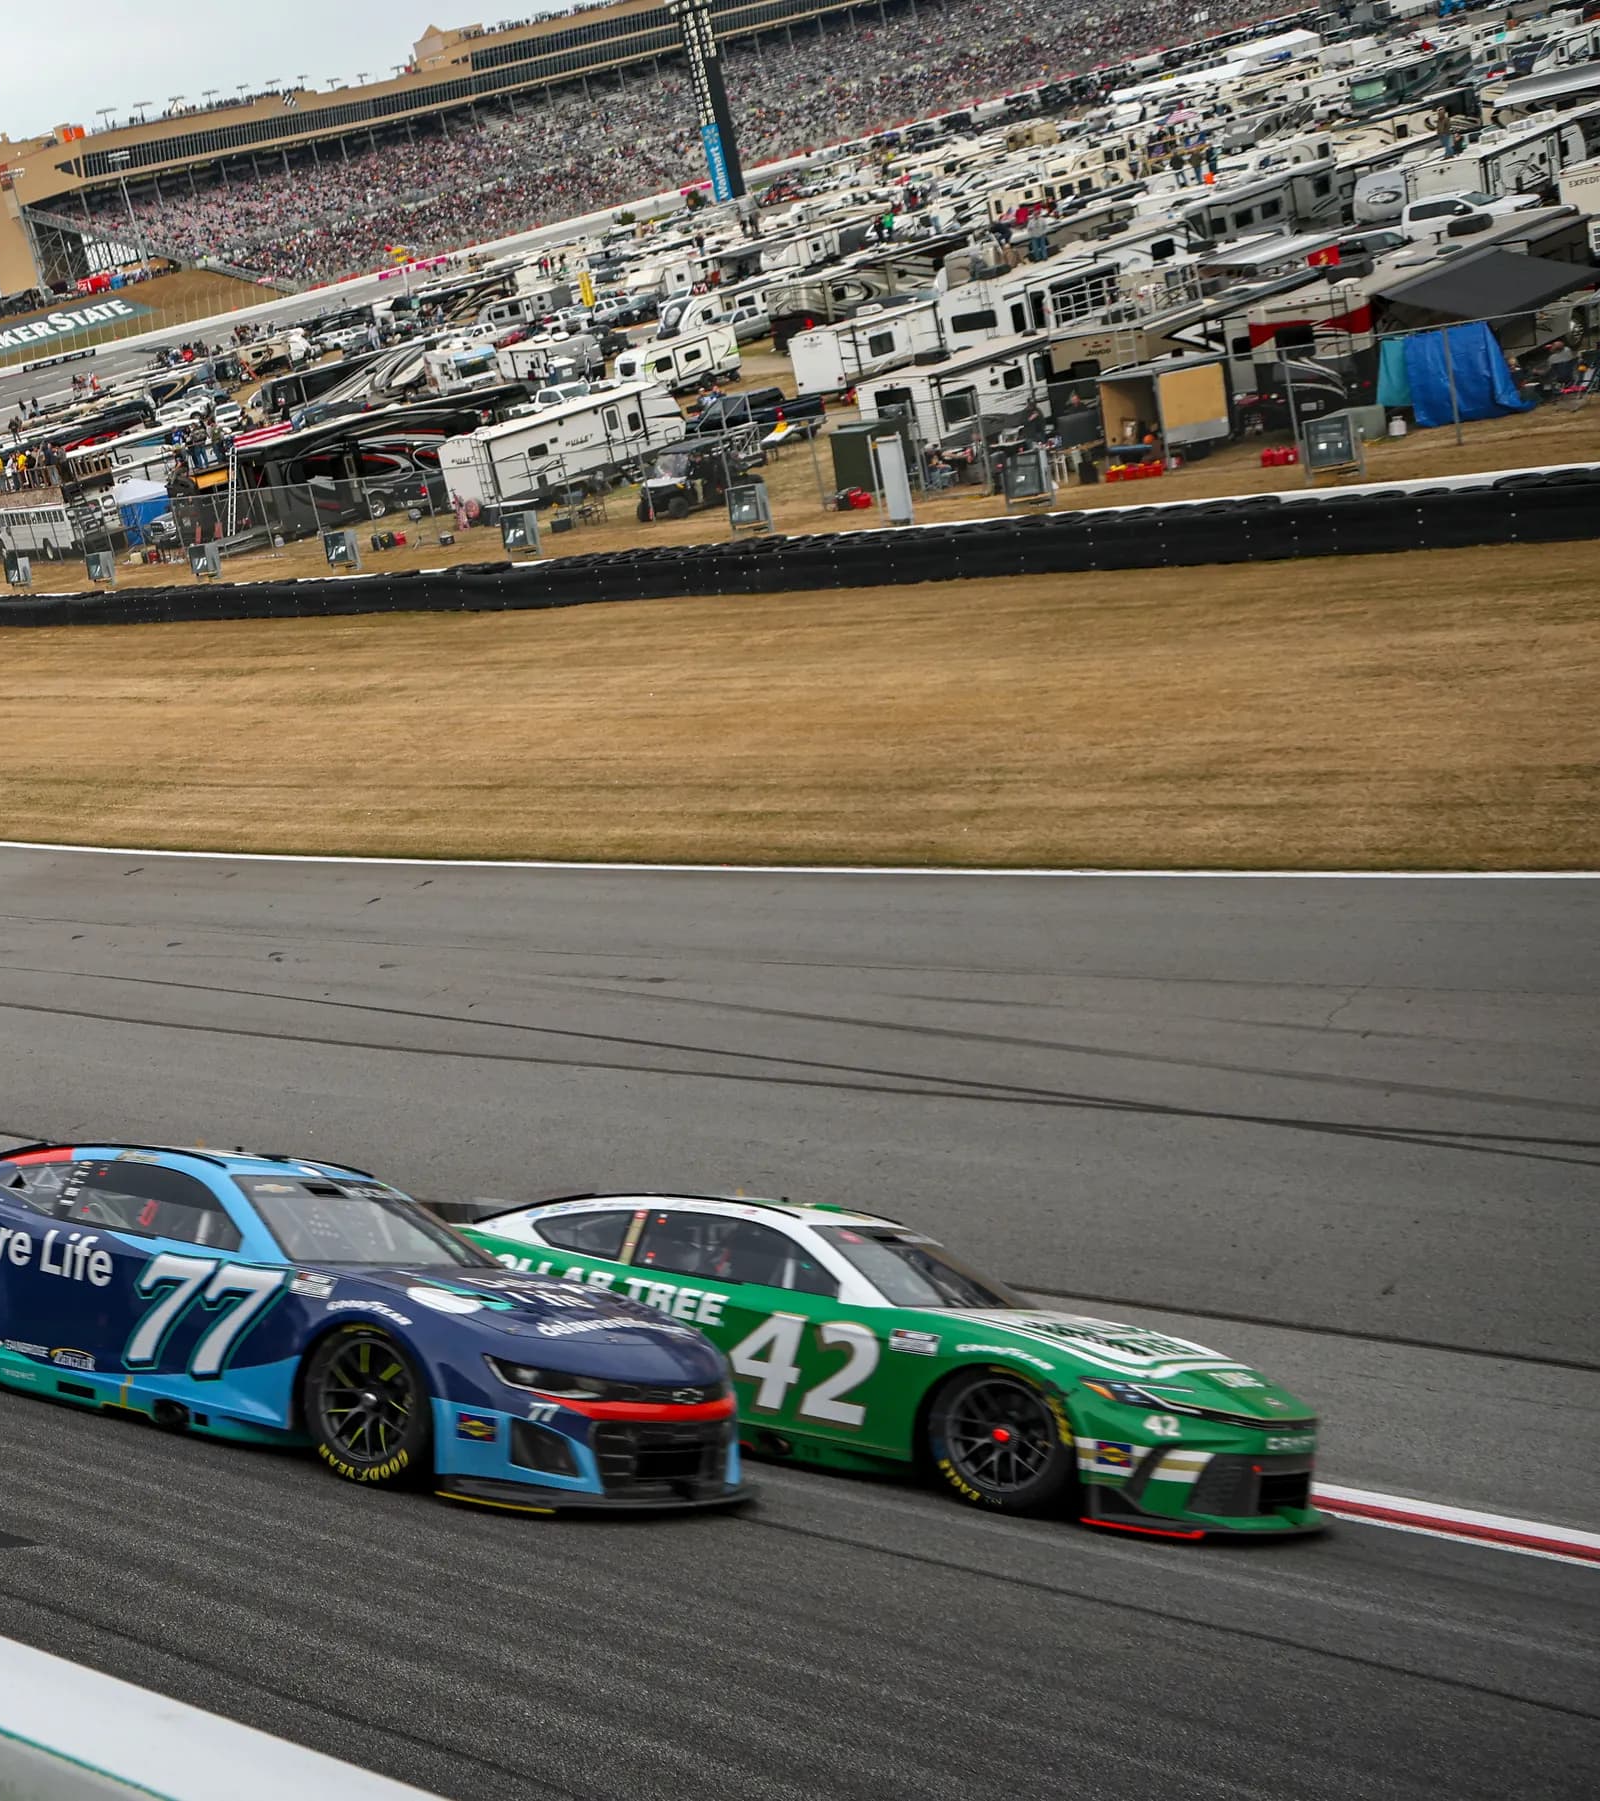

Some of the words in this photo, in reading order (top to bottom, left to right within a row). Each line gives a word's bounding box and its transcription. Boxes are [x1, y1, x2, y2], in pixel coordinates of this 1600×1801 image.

[710, 146, 730, 200] Walmart
[1568, 177, 1600, 189] EXPEDI
[47, 299, 134, 334] STATE
[38, 1229, 114, 1288] Life
[122, 1251, 293, 1380] 77
[623, 1276, 732, 1327] TREE
[730, 1311, 881, 1428] 42
[526, 1402, 561, 1423] 77
[1141, 1414, 1183, 1437] 42
[318, 1442, 410, 1482] GOODYEAR
